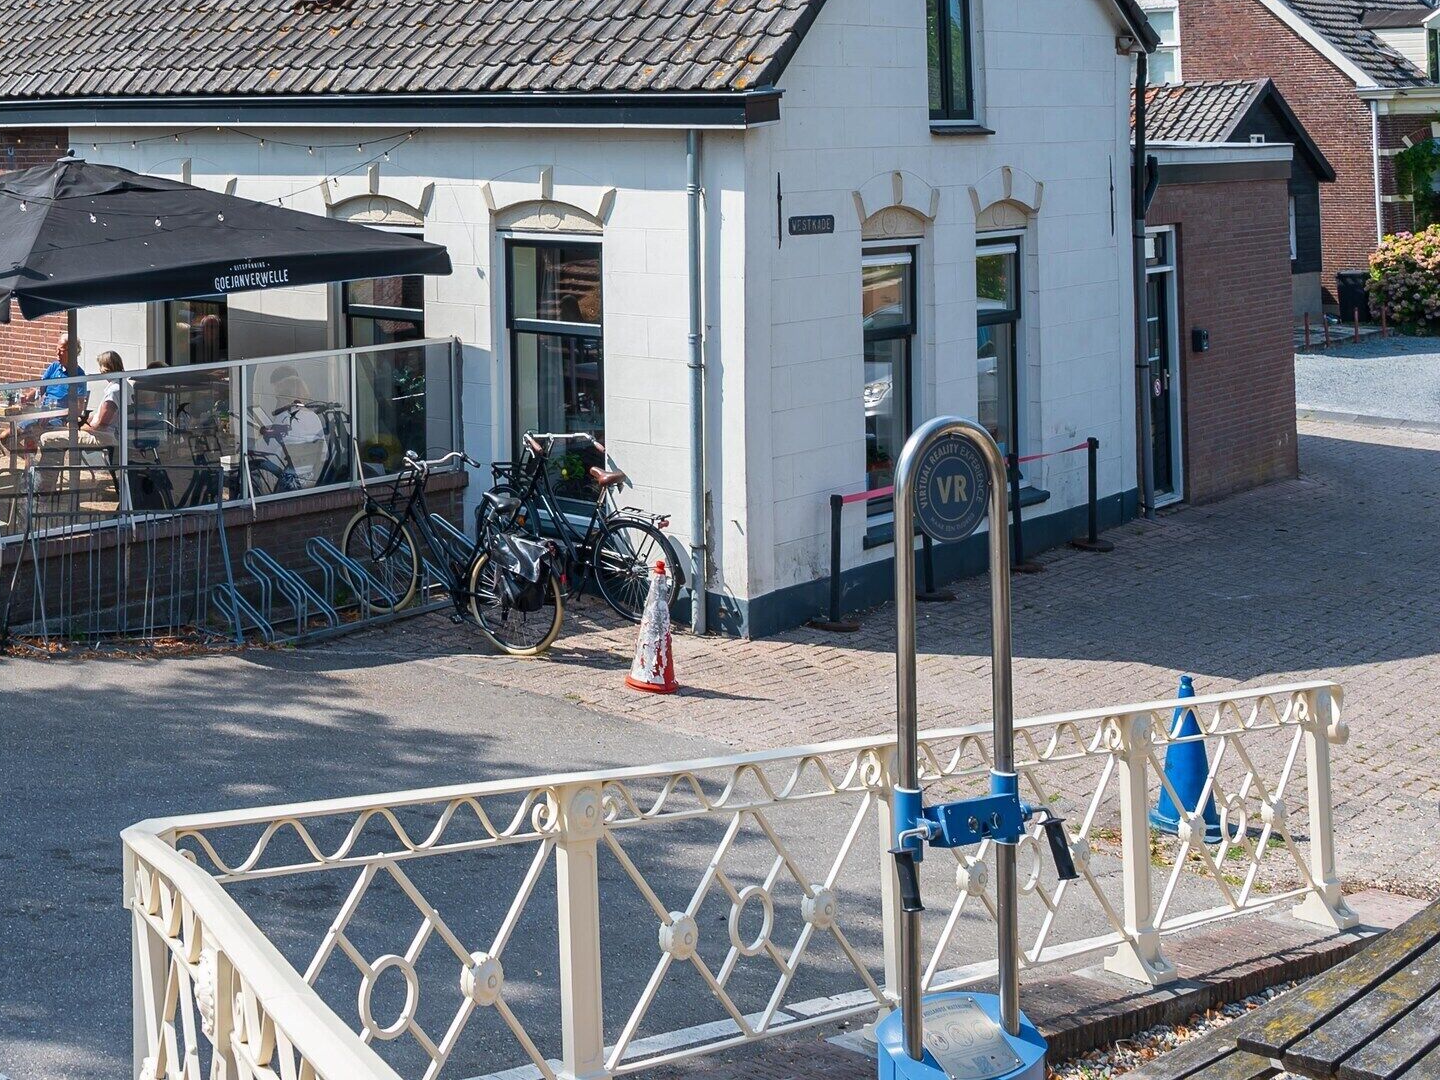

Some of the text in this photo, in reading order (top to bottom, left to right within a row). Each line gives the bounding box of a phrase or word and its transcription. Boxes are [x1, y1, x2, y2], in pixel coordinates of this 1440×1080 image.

[214, 269, 289, 292] GOEJANVERWELLE
[919, 443, 985, 509] VIRTUAL REALITY EXPERIENCE
[936, 475, 968, 504] VR
